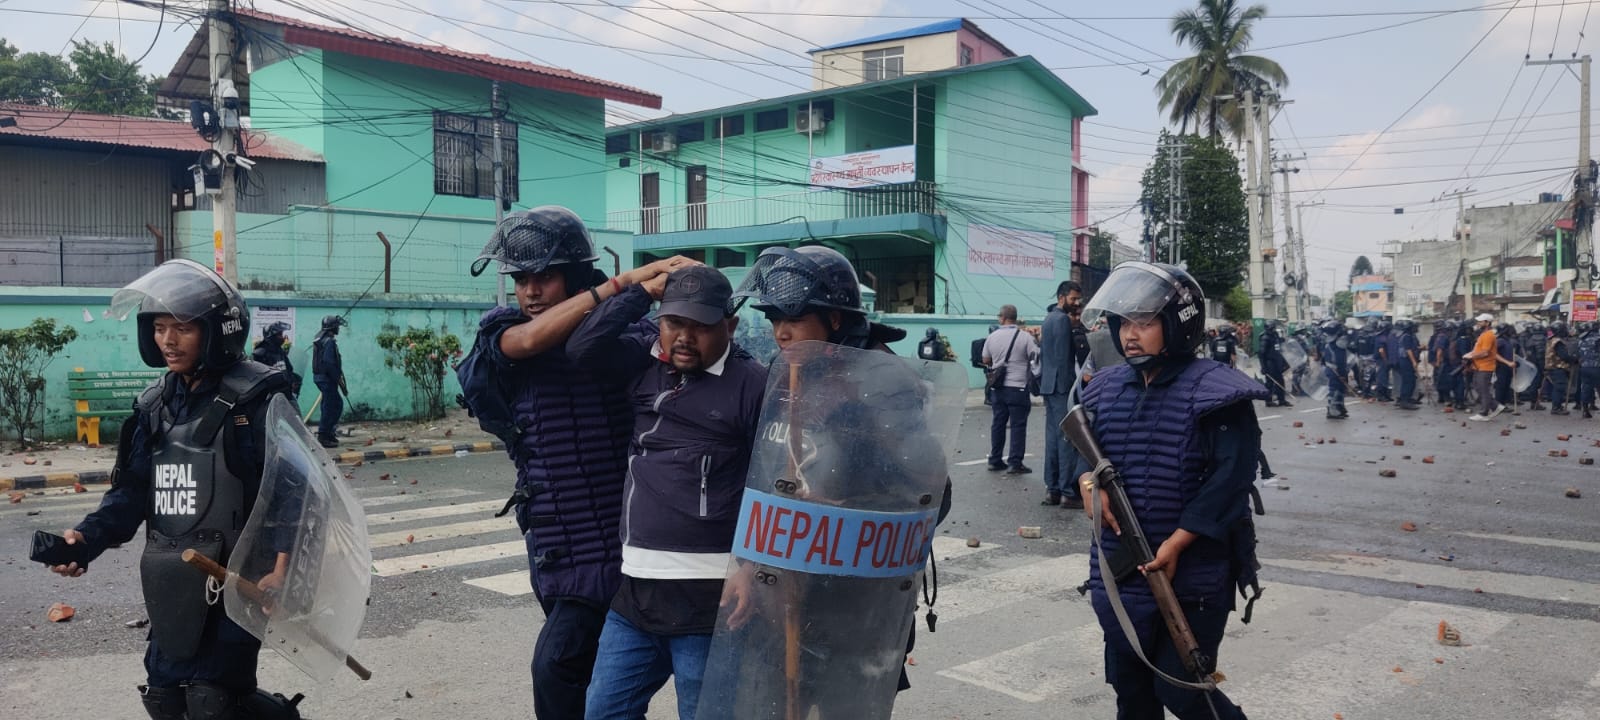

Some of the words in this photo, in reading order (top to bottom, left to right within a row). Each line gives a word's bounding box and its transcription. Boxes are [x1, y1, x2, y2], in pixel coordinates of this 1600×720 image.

[1178, 303, 1199, 323] NEPAL
[221, 319, 243, 336] NEPAL
[155, 463, 197, 488] NEPAL
[155, 490, 197, 515] POLICE
[743, 500, 844, 567] NEPAL
[852, 516, 934, 569] POLICE
